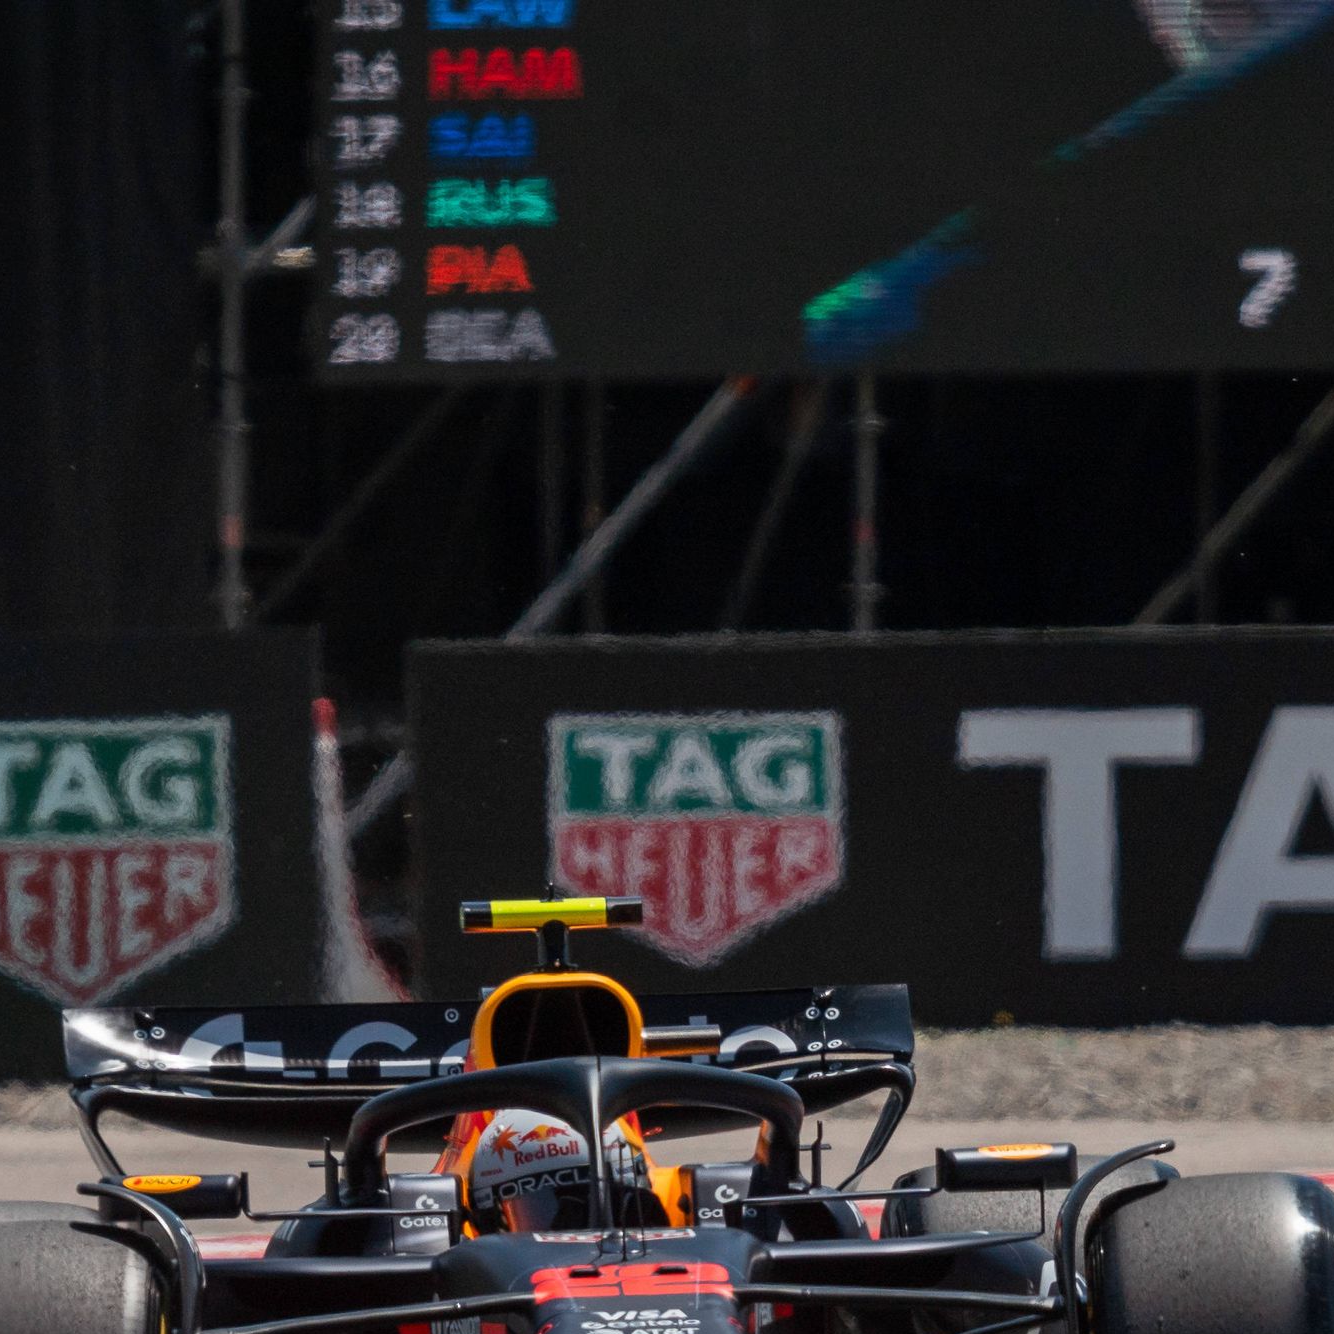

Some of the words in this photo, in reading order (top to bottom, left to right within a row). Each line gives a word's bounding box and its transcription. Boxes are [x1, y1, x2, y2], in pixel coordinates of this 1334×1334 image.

[331, 50, 402, 100] 16
[427, 47, 583, 100] HAM
[331, 114, 401, 163] 17
[426, 177, 557, 228] RUS
[426, 244, 534, 295] PIA
[1238, 247, 1298, 327] 7
[574, 729, 809, 805] TAG
[579, 824, 823, 932] HEUER
[514, 1148, 546, 1167] Red
[547, 1140, 580, 1159] Bull
[499, 1168, 591, 1199] ORACL
[593, 1309, 688, 1320] VISA
